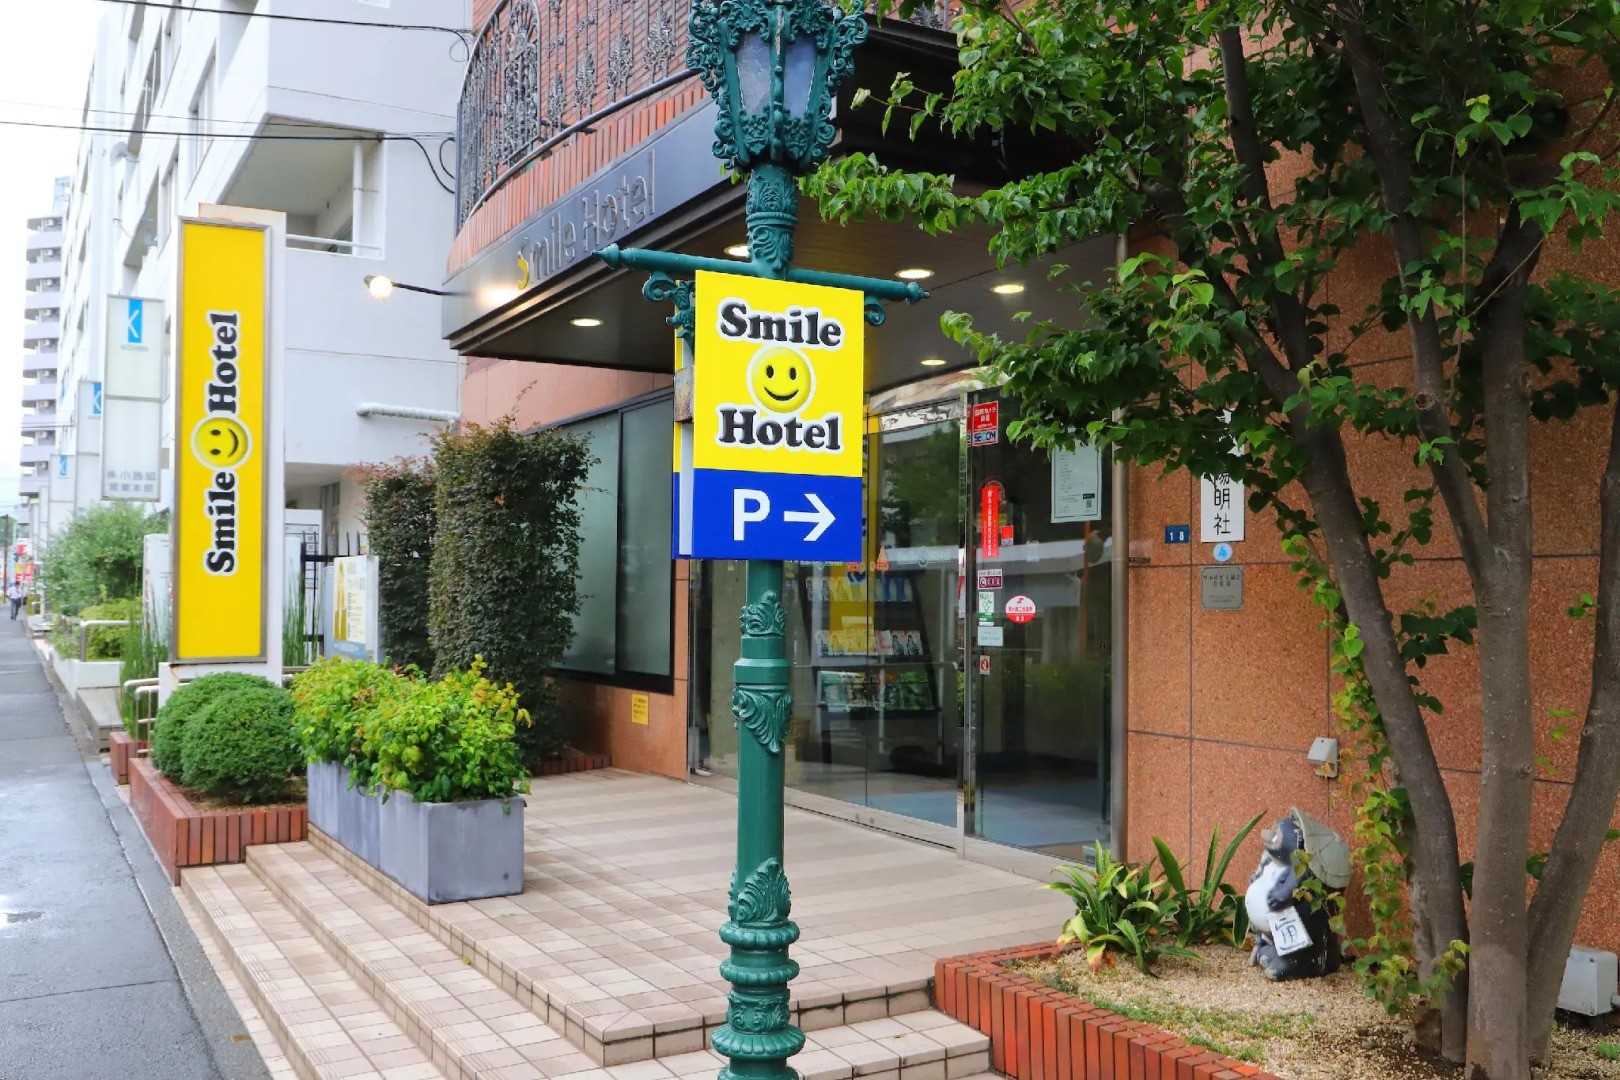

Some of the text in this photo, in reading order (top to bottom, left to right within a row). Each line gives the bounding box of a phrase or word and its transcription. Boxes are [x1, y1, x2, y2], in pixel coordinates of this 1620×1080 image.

[517, 149, 655, 290] Smile Hotel
[721, 303, 841, 347] Smile
[207, 313, 238, 574] Smile Hotel
[719, 408, 841, 451] Hotel
[974, 430, 996, 443] SECOM
[733, 488, 771, 541] P
